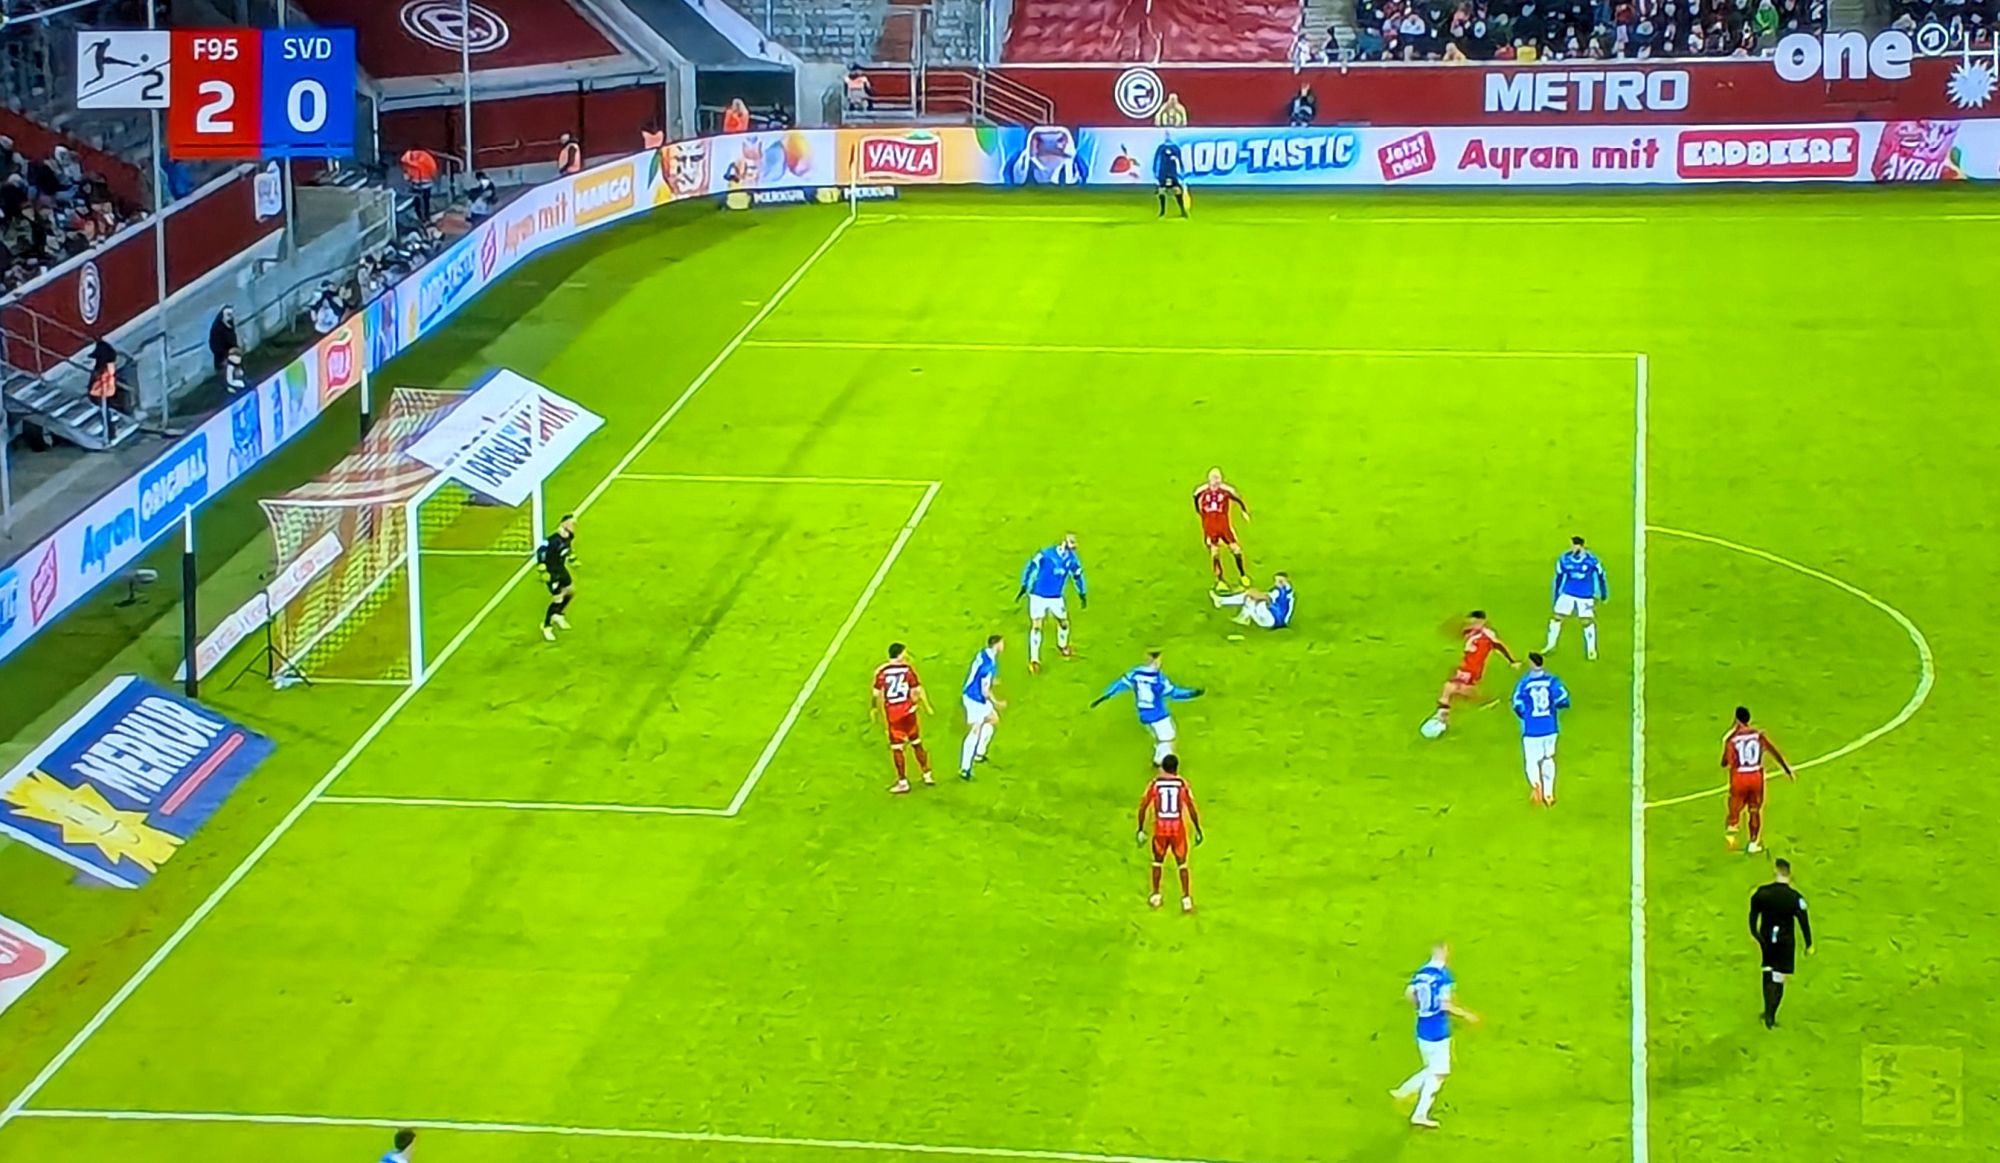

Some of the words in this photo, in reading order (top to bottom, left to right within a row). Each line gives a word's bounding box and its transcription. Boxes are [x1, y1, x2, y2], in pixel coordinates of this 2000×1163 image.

[1485, 71, 1690, 112] METRO
[868, 142, 934, 171] YAYLA
[1385, 136, 1426, 164] Jetzt
[1391, 150, 1428, 178] neu!
[1457, 139, 1579, 179] Ayran
[1592, 138, 1660, 169] mit
[1683, 137, 1853, 167] ERDBEERE
[538, 191, 569, 232] mit
[70, 696, 226, 804] MERKUR
[1735, 739, 1760, 766] 10
[1158, 786, 1179, 813] 11
